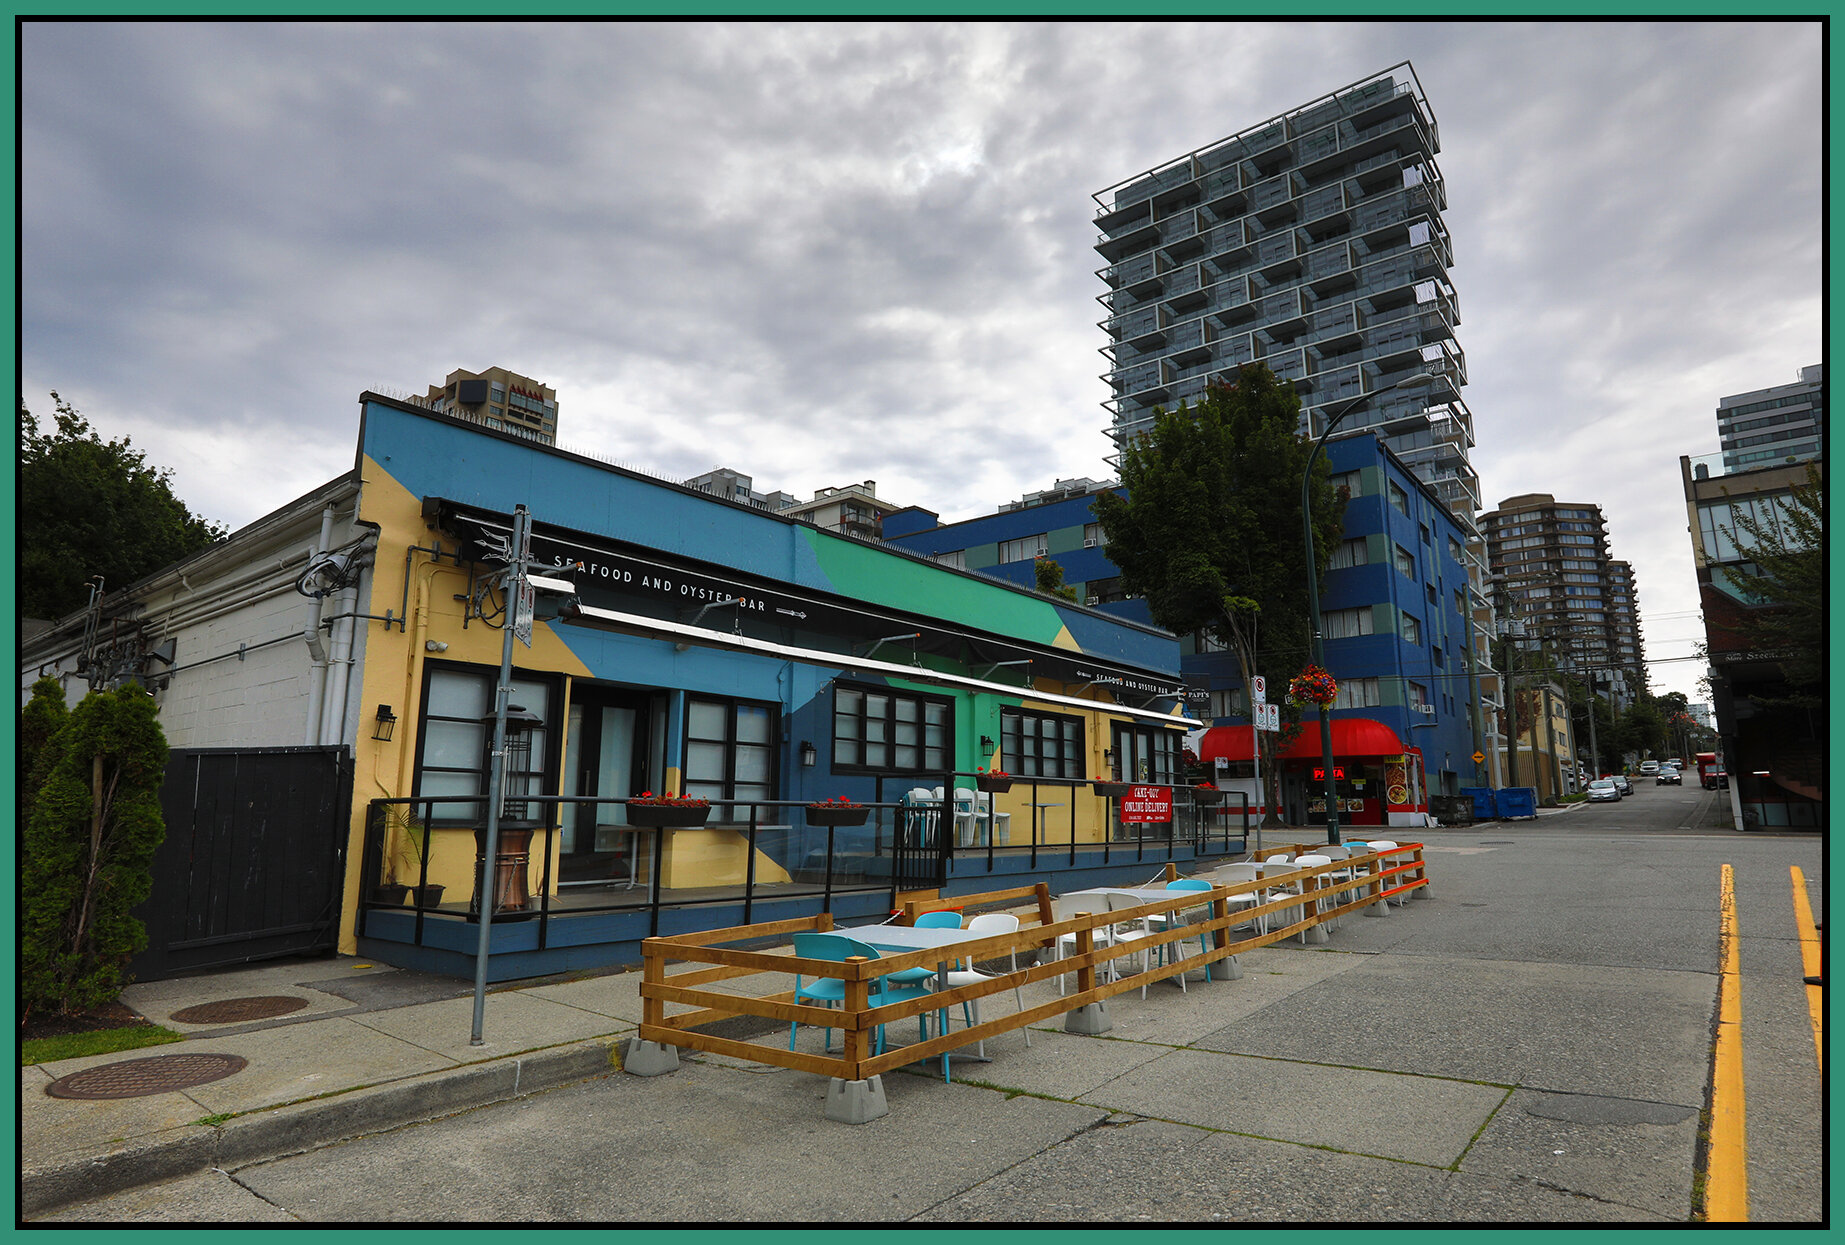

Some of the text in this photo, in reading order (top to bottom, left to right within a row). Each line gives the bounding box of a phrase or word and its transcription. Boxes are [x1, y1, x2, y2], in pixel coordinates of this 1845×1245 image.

[554, 555, 764, 611] SEAFOOD AND OYSTER BAR
[1125, 679, 1137, 689] AND
[1138, 682, 1157, 693] OYSTER
[1158, 686, 1168, 695] BAR
[1134, 787, 1160, 799] TAKE-OUT
[1125, 801, 1168, 813] ONLINE DELIVERY
